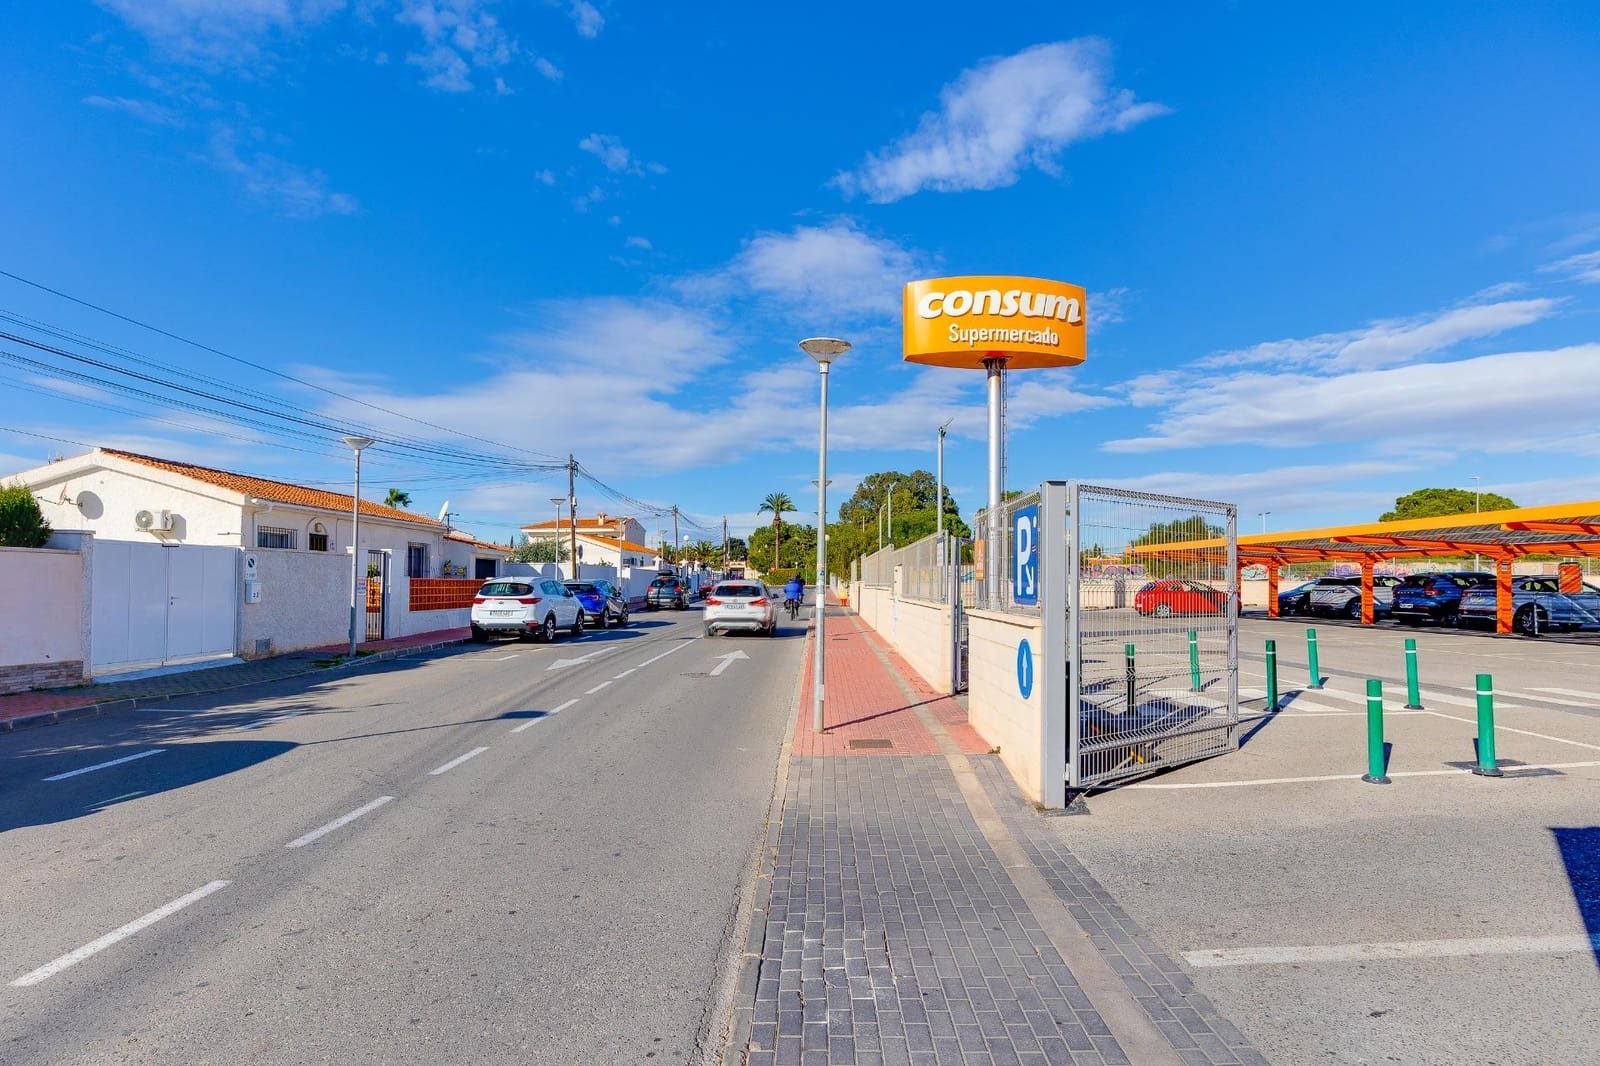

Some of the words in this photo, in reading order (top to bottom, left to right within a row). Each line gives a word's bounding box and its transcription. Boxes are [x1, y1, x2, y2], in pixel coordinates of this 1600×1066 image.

[919, 289, 1081, 323] consum
[949, 324, 1059, 346] Supermercado
[1017, 516, 1032, 596] P
